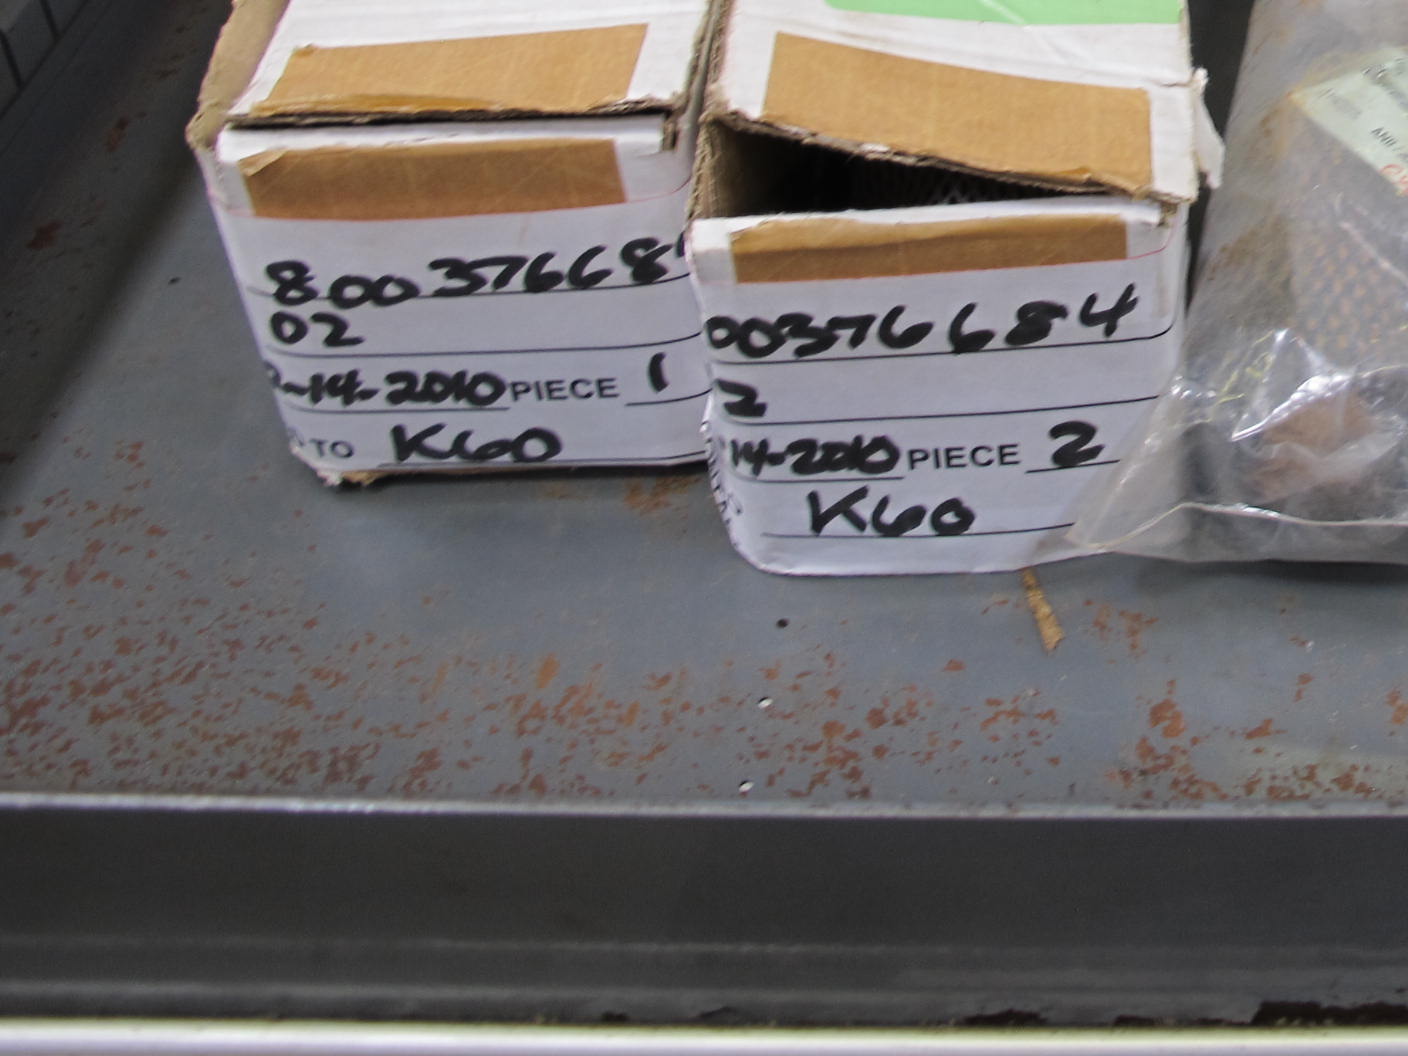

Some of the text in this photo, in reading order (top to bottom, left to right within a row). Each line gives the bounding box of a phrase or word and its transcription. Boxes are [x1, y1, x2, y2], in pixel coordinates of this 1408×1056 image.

[270, 311, 365, 346] 02
[510, 377, 621, 403] PIECE
[906, 444, 1024, 471] PIECE
[1048, 420, 1106, 470] 2
